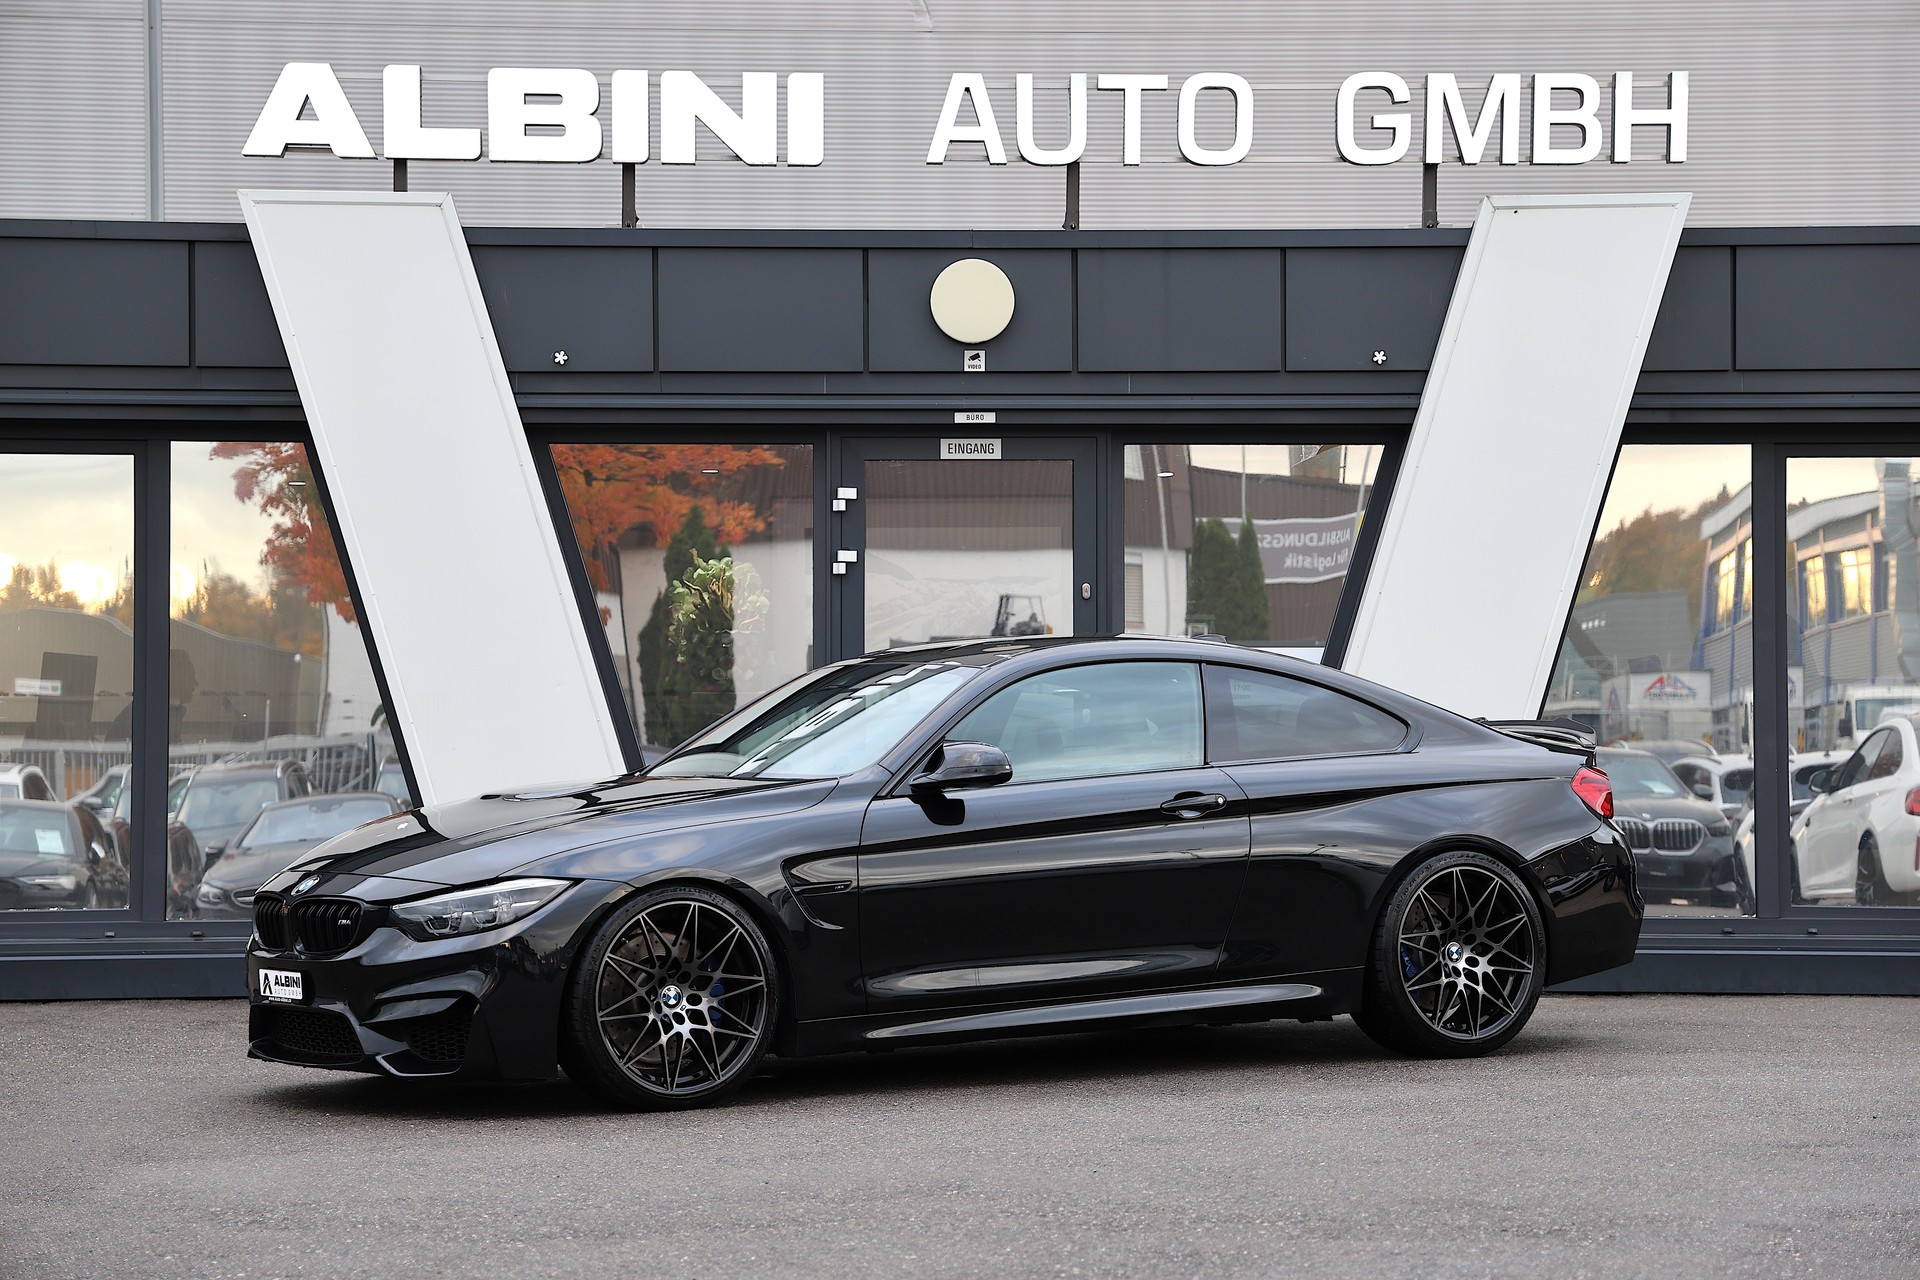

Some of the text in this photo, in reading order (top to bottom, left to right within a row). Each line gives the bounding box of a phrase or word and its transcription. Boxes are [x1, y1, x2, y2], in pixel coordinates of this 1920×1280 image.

[242, 62, 1690, 167] ALBINI AUTO GMBH
[966, 413, 985, 421] BÜRO
[948, 443, 995, 454] EINGANG
[274, 974, 300, 988] ALBINI
